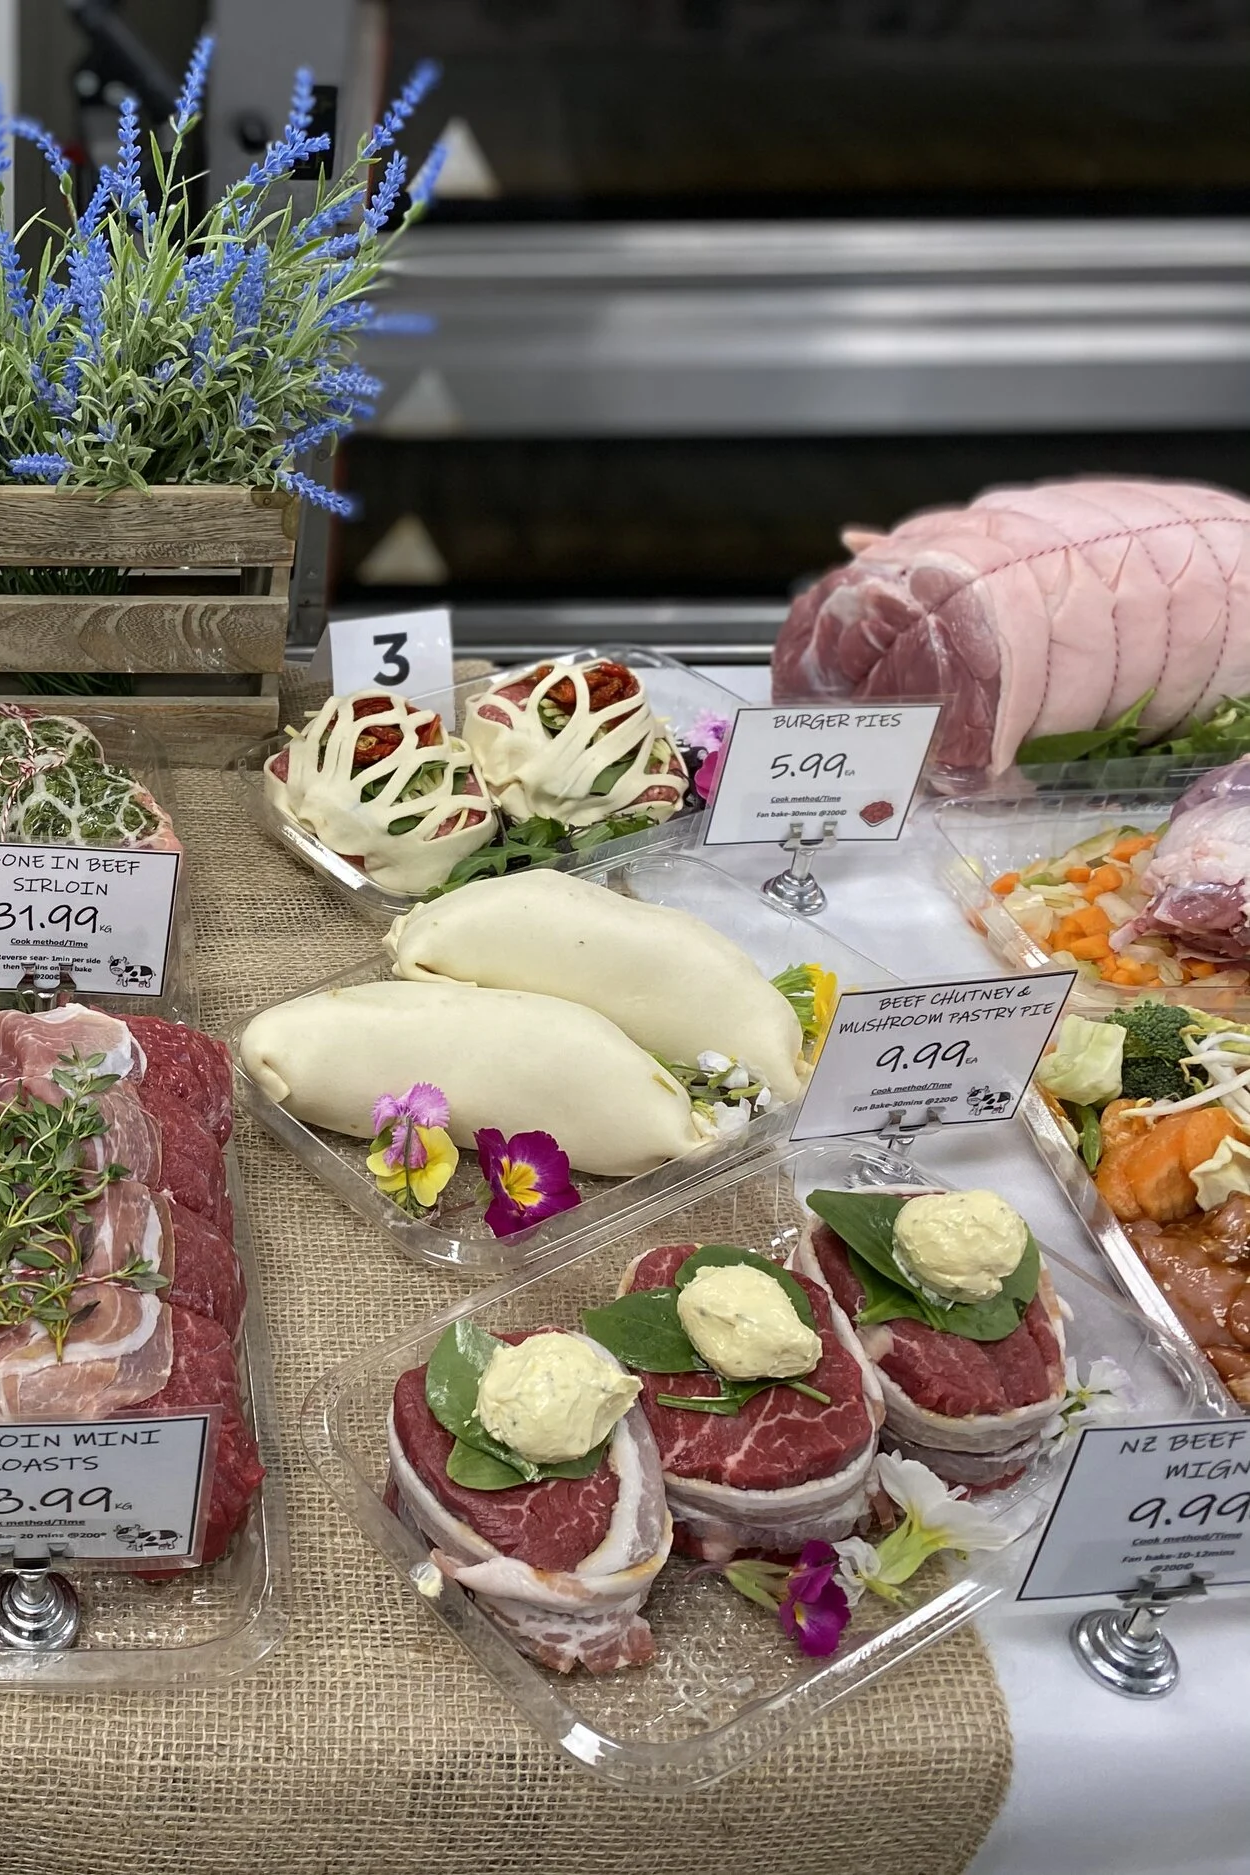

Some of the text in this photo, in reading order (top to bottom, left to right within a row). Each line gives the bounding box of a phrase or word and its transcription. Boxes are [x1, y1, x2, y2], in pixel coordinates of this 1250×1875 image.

[373, 632, 410, 686] 3
[773, 713, 902, 730] BURGER PIES
[770, 752, 848, 779] 5.99
[50, 856, 79, 870] IN
[86, 858, 140, 875] BEEF
[13, 877, 108, 896] SIRLOIN
[10, 938, 88, 948] Cook method/Time
[879, 986, 1032, 1010] BEEF CHUTNEY &
[839, 1002, 1056, 1034] MUSHROOM PASTRY PIE
[876, 1040, 970, 1073] 9.99
[870, 1083, 952, 1096] Cook method/Time
[74, 1429, 162, 1447] MINI
[1119, 1431, 1247, 1455] NZ BEEF
[1128, 1492, 1250, 1529] 9.99
[6, 1519, 86, 1527] method/Time
[1131, 1533, 1243, 1547] Cook method/Time
